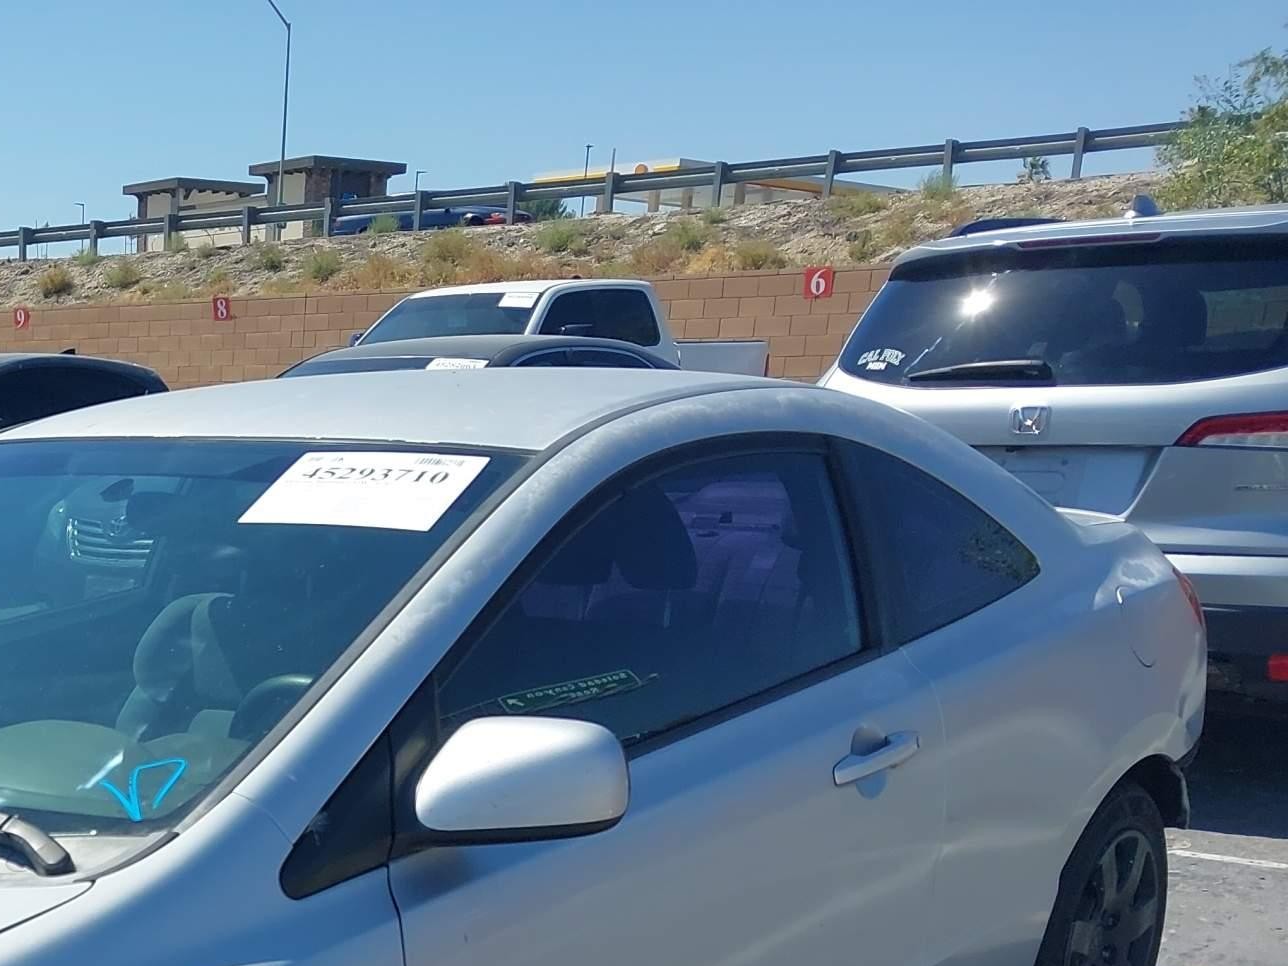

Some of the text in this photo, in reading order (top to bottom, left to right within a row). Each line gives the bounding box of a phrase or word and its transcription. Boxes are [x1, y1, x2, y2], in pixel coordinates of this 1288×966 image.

[810, 268, 827, 296] 6
[216, 298, 227, 319] 8
[16, 309, 25, 329] 9
[302, 466, 451, 485] 45293710
